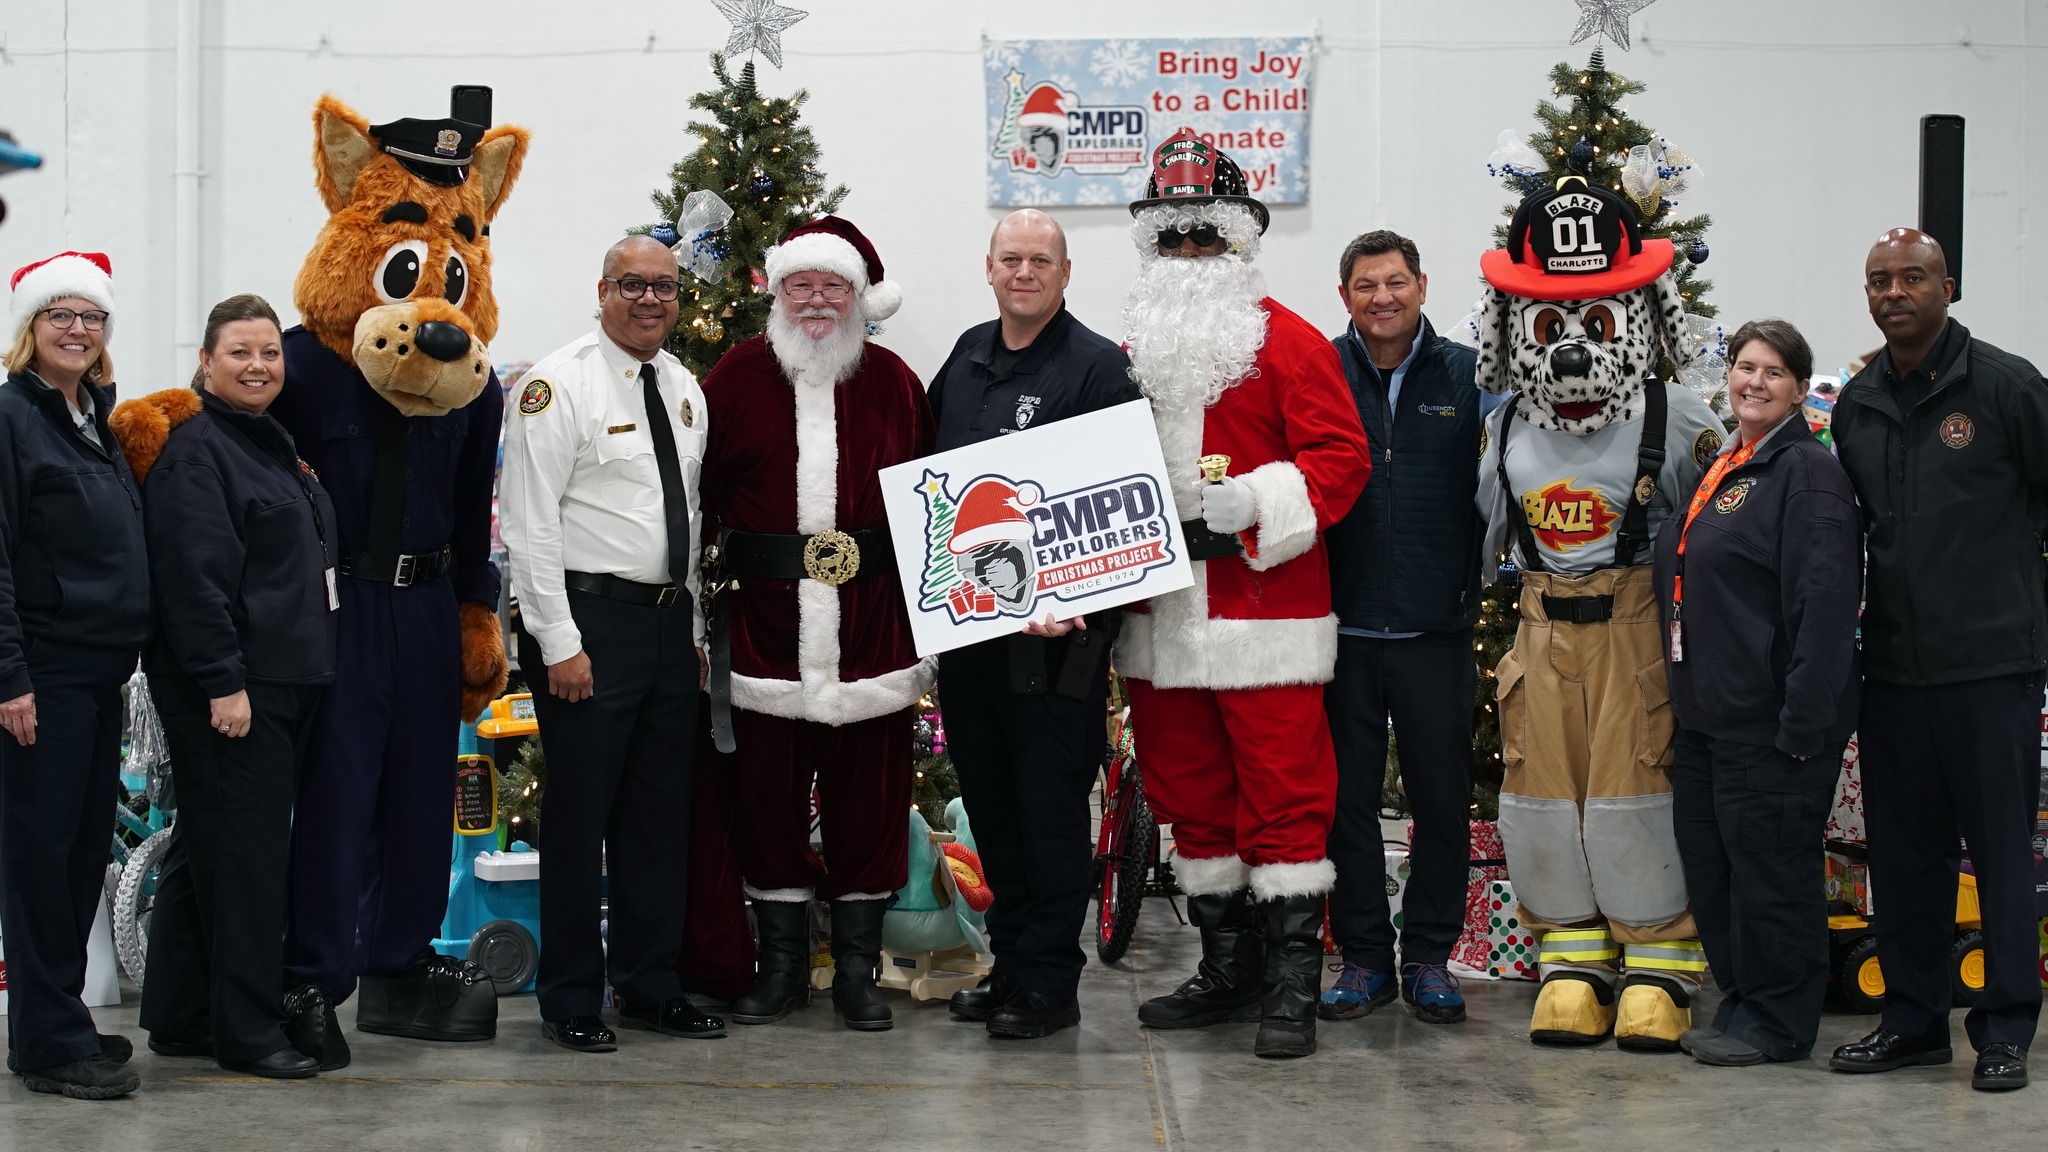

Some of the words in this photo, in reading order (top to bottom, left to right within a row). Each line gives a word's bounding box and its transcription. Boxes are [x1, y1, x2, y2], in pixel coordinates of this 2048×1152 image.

[1159, 51, 1237, 80] Bring
[1250, 51, 1302, 79] Joy
[1152, 91, 1182, 112] to
[1195, 95, 1210, 111] a
[1223, 89, 1308, 111] Child!
[1068, 111, 1143, 135] CMPD
[1187, 128, 1284, 148] onate
[1165, 152, 1205, 166] CHARLOTTE
[1173, 185, 1195, 194] SANTA
[1549, 195, 1600, 215] BLAZE
[1552, 215, 1602, 253] 01
[1550, 258, 1604, 267] CHARLOTTE
[1025, 481, 1156, 548] CMPD
[1036, 520, 1161, 567] EXPLORERS
[1043, 558, 1105, 586] CHRISTMAS
[1107, 546, 1154, 569] PROJECT
[1064, 578, 1102, 594] SINCE
[1109, 570, 1135, 583] 1974
